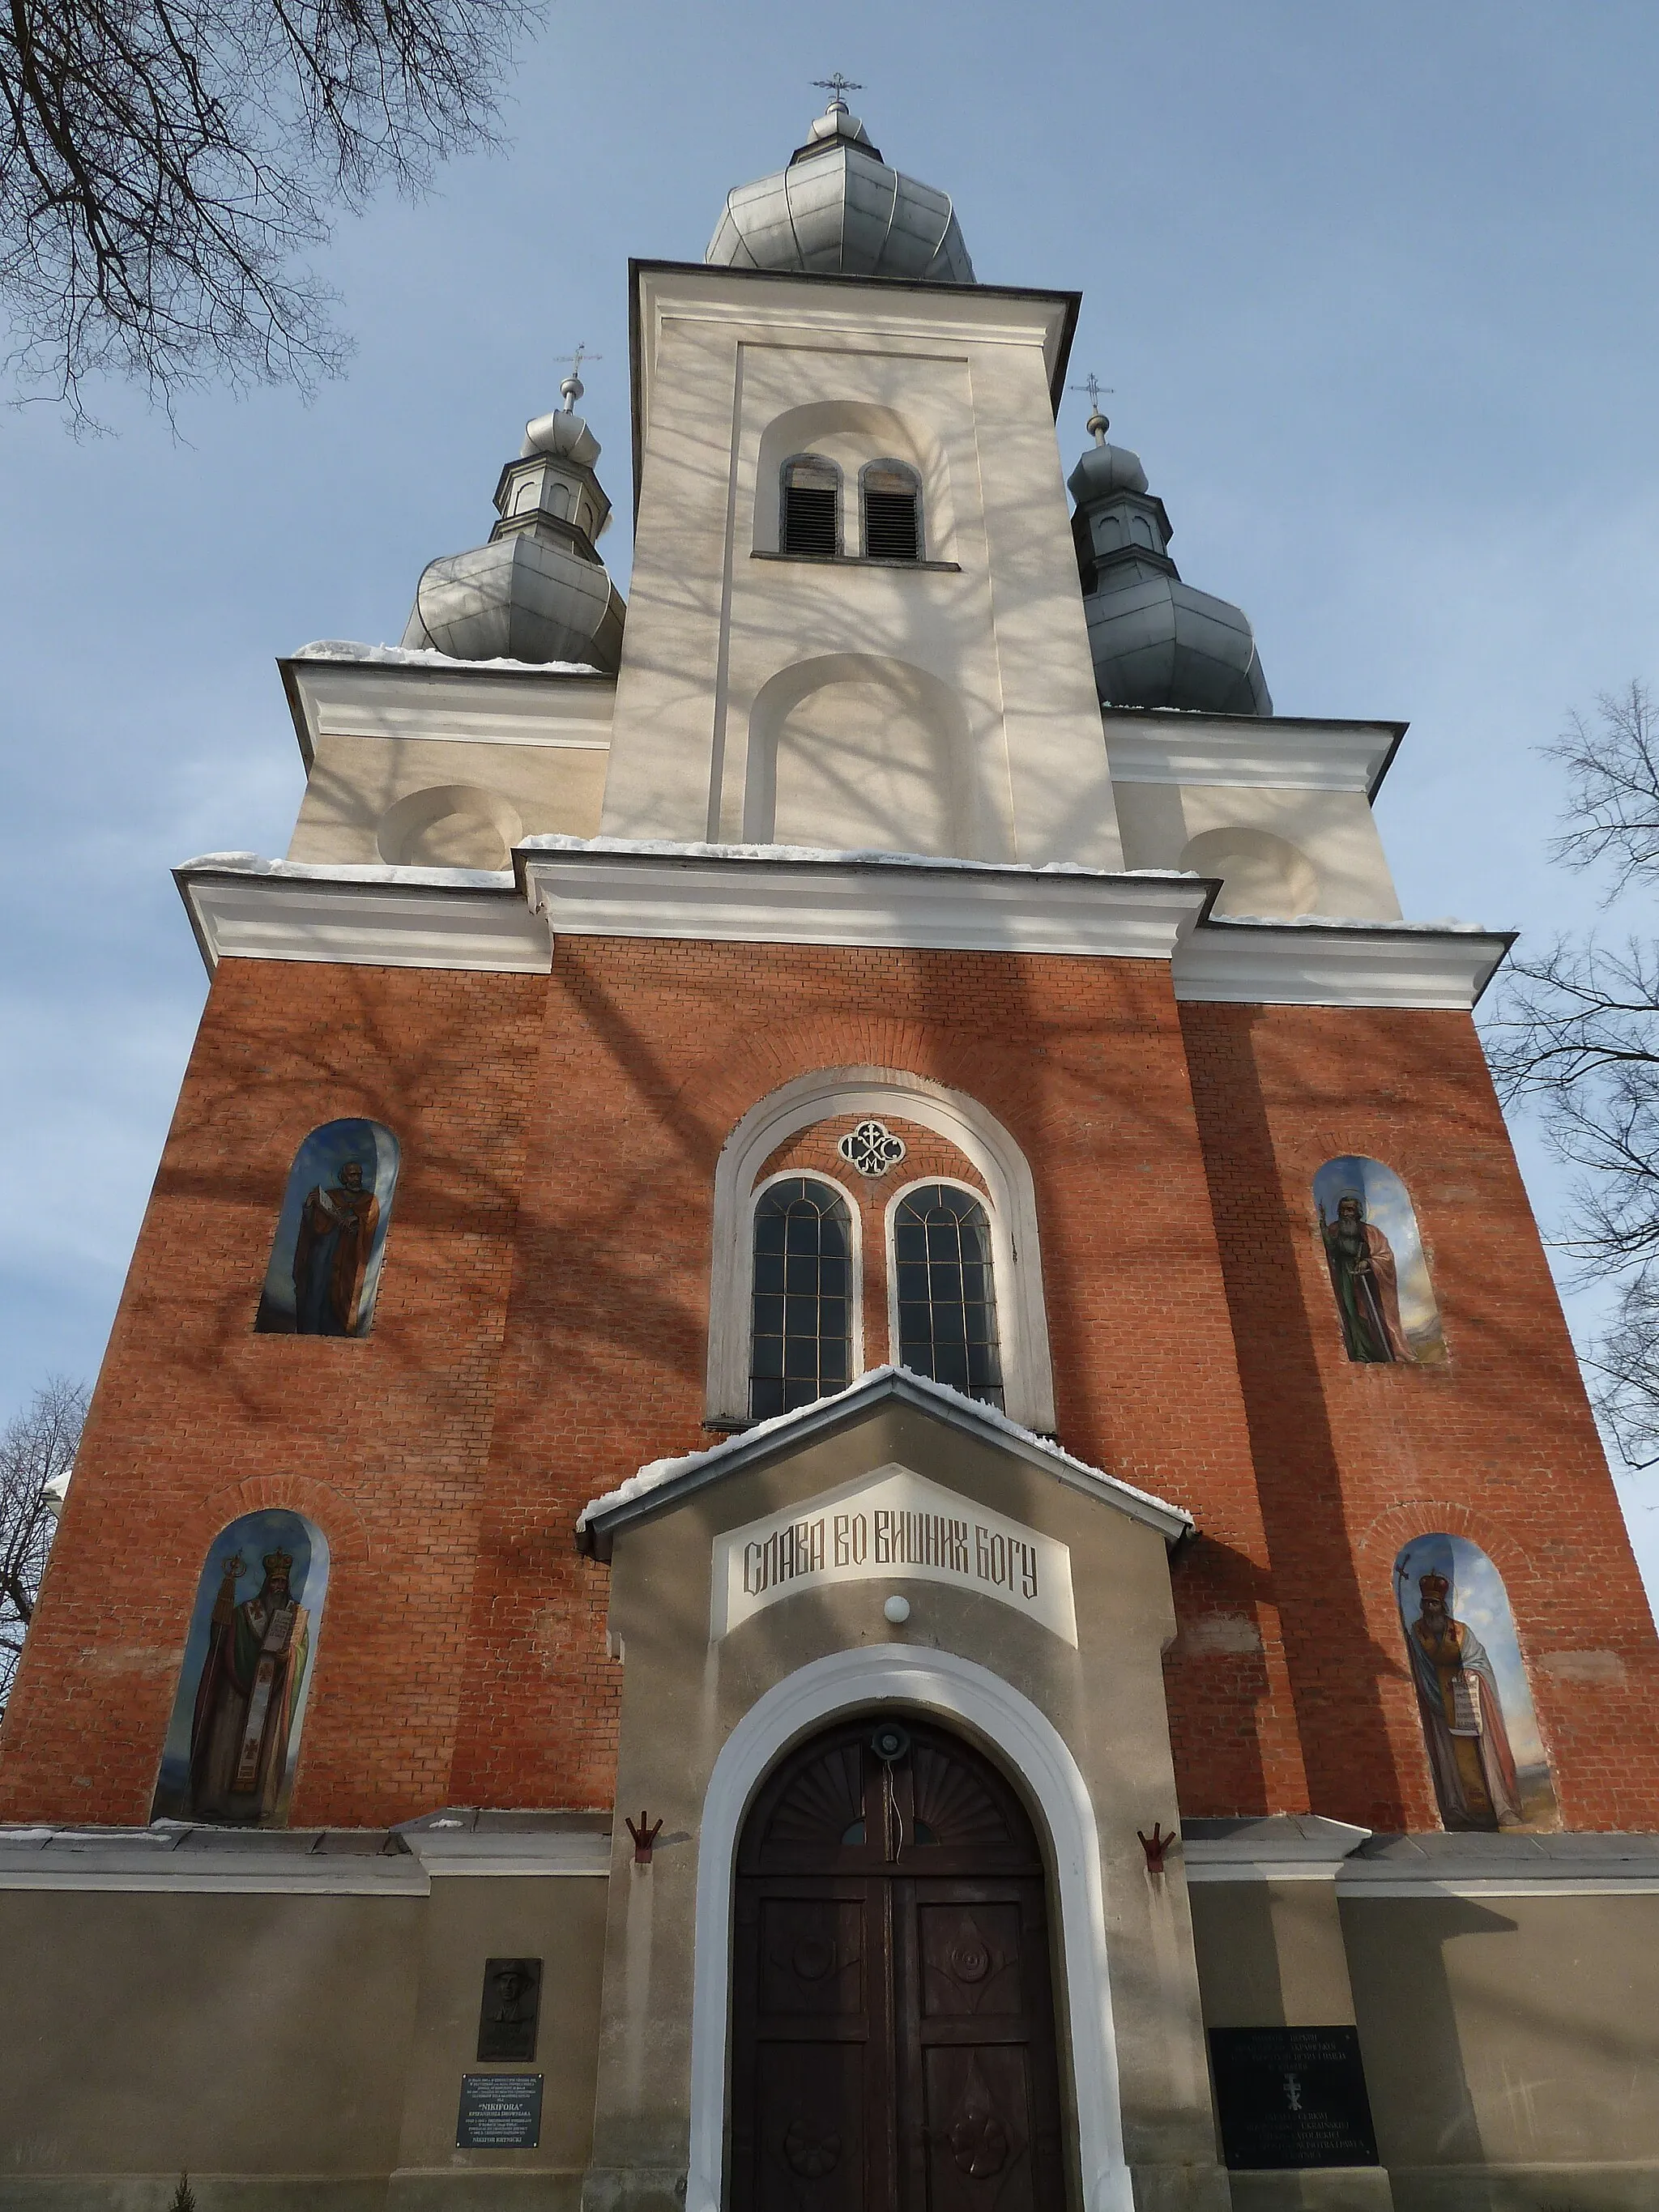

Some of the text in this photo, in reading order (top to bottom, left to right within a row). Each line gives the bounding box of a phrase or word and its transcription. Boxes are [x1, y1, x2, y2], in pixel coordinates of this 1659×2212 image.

[743, 1510, 1038, 1600] СЛАВА ВО ВИШНИХ БОГУ
